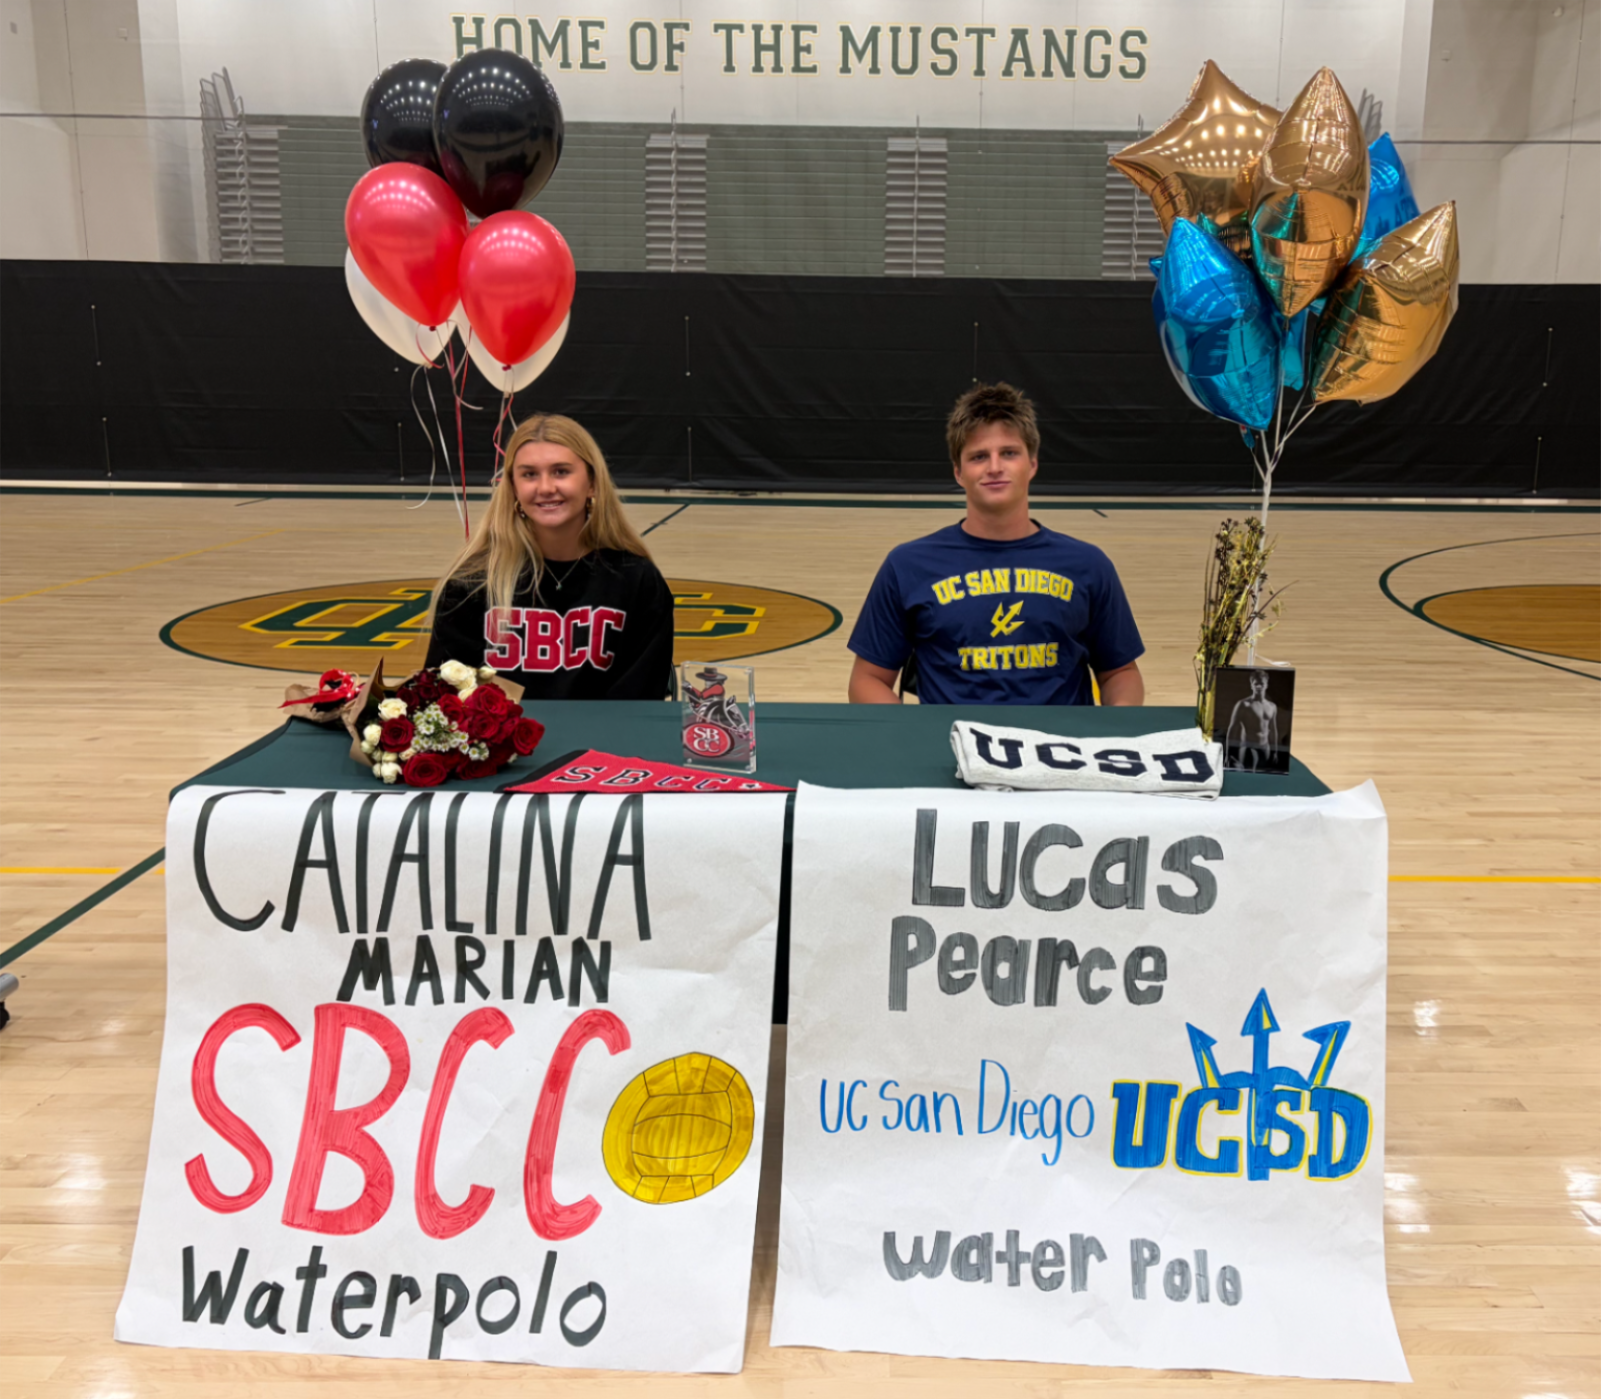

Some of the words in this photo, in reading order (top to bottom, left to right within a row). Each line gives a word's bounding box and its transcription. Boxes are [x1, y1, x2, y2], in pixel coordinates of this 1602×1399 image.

[452, 14, 606, 70] HOME
[629, 20, 693, 73] OF
[712, 21, 818, 75] THE
[838, 23, 1149, 81] MUSTANGS
[931, 575, 966, 605] UC
[964, 568, 1011, 597] SAN
[1014, 568, 1075, 602] DIEGO
[484, 606, 626, 673] SBCC
[957, 642, 1060, 671] TRITONS
[550, 765, 731, 791] SBCC
[969, 727, 1215, 784] UCSD
[193, 788, 652, 941] CATALINA
[336, 934, 612, 1007] MARIAN
[887, 915, 1169, 1012] Pearce
[184, 1002, 632, 1241] SBCC
[819, 1078, 868, 1133] UC
[881, 1079, 965, 1136] San
[976, 1059, 1095, 1166] Diego
[1110, 1078, 1373, 1181] UCSD
[181, 1244, 608, 1360] Waterpolo
[1130, 1236, 1244, 1307] Polo
